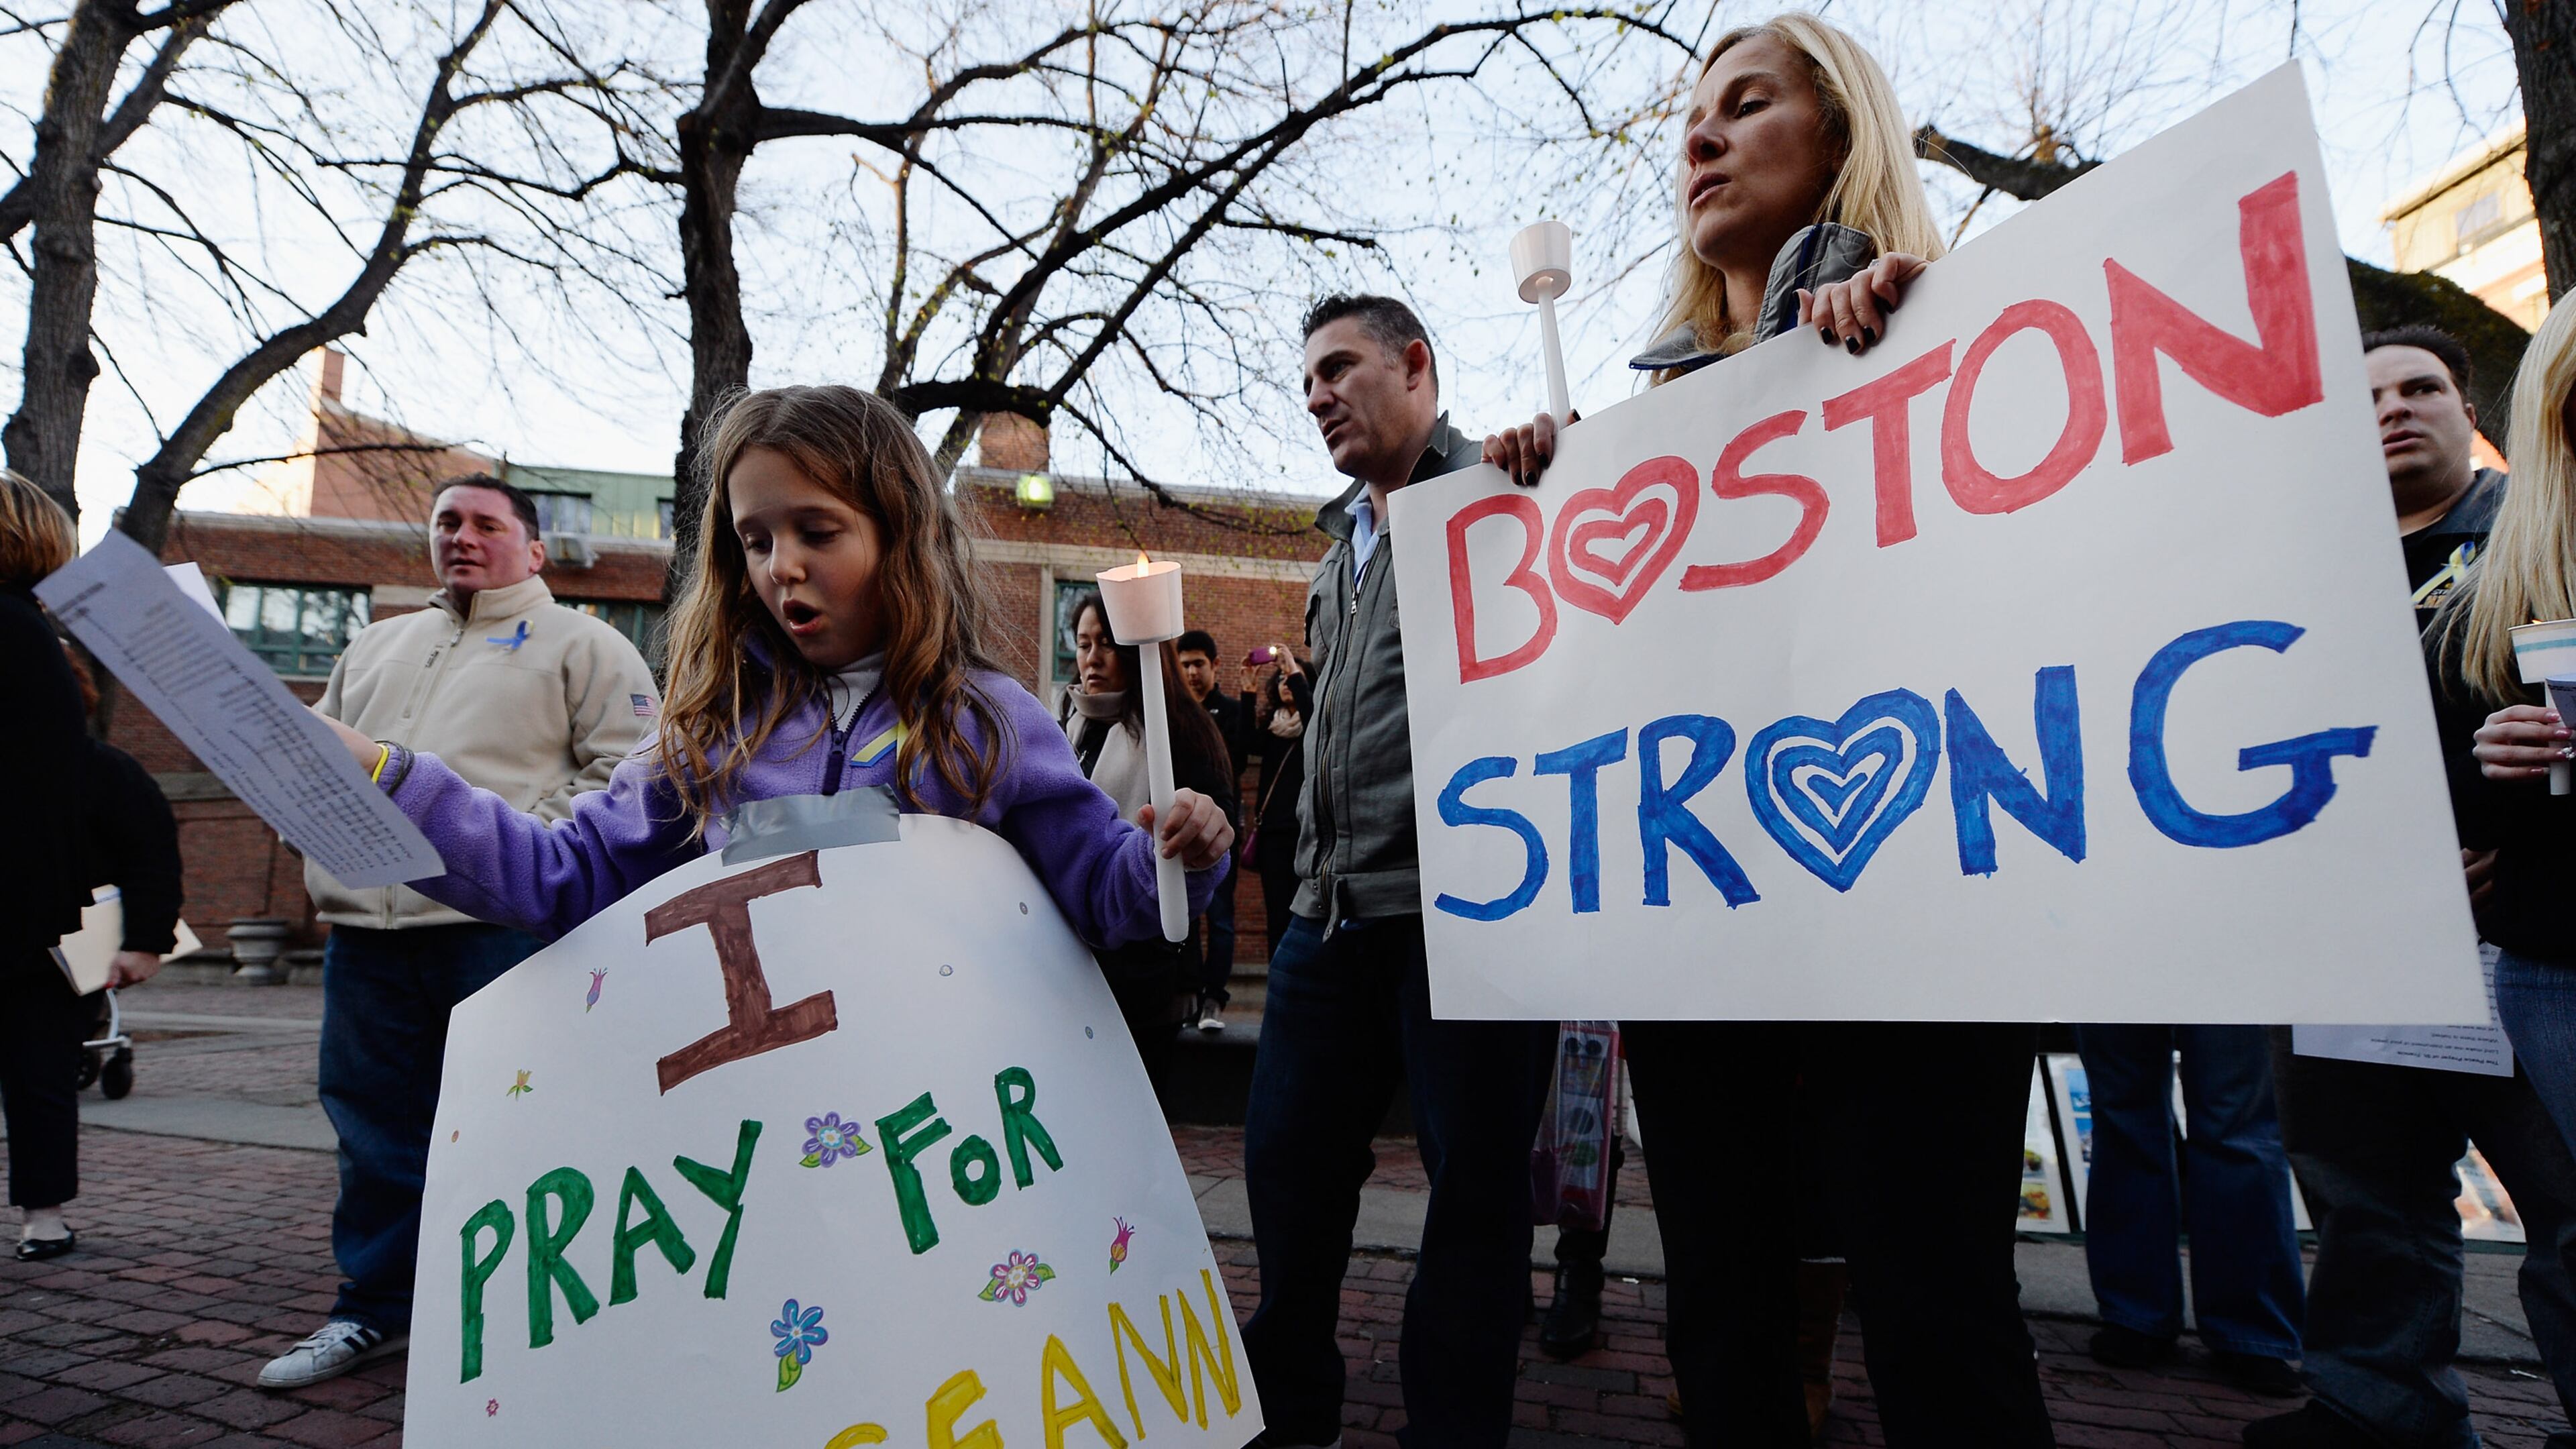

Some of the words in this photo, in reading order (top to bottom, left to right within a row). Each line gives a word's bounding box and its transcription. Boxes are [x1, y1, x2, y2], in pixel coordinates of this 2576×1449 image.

[1446, 172, 2324, 684] BOSTON
[1435, 621, 2377, 921] STRONG
[645, 850, 837, 1095] I
[460, 1120, 763, 1383] PRAY
